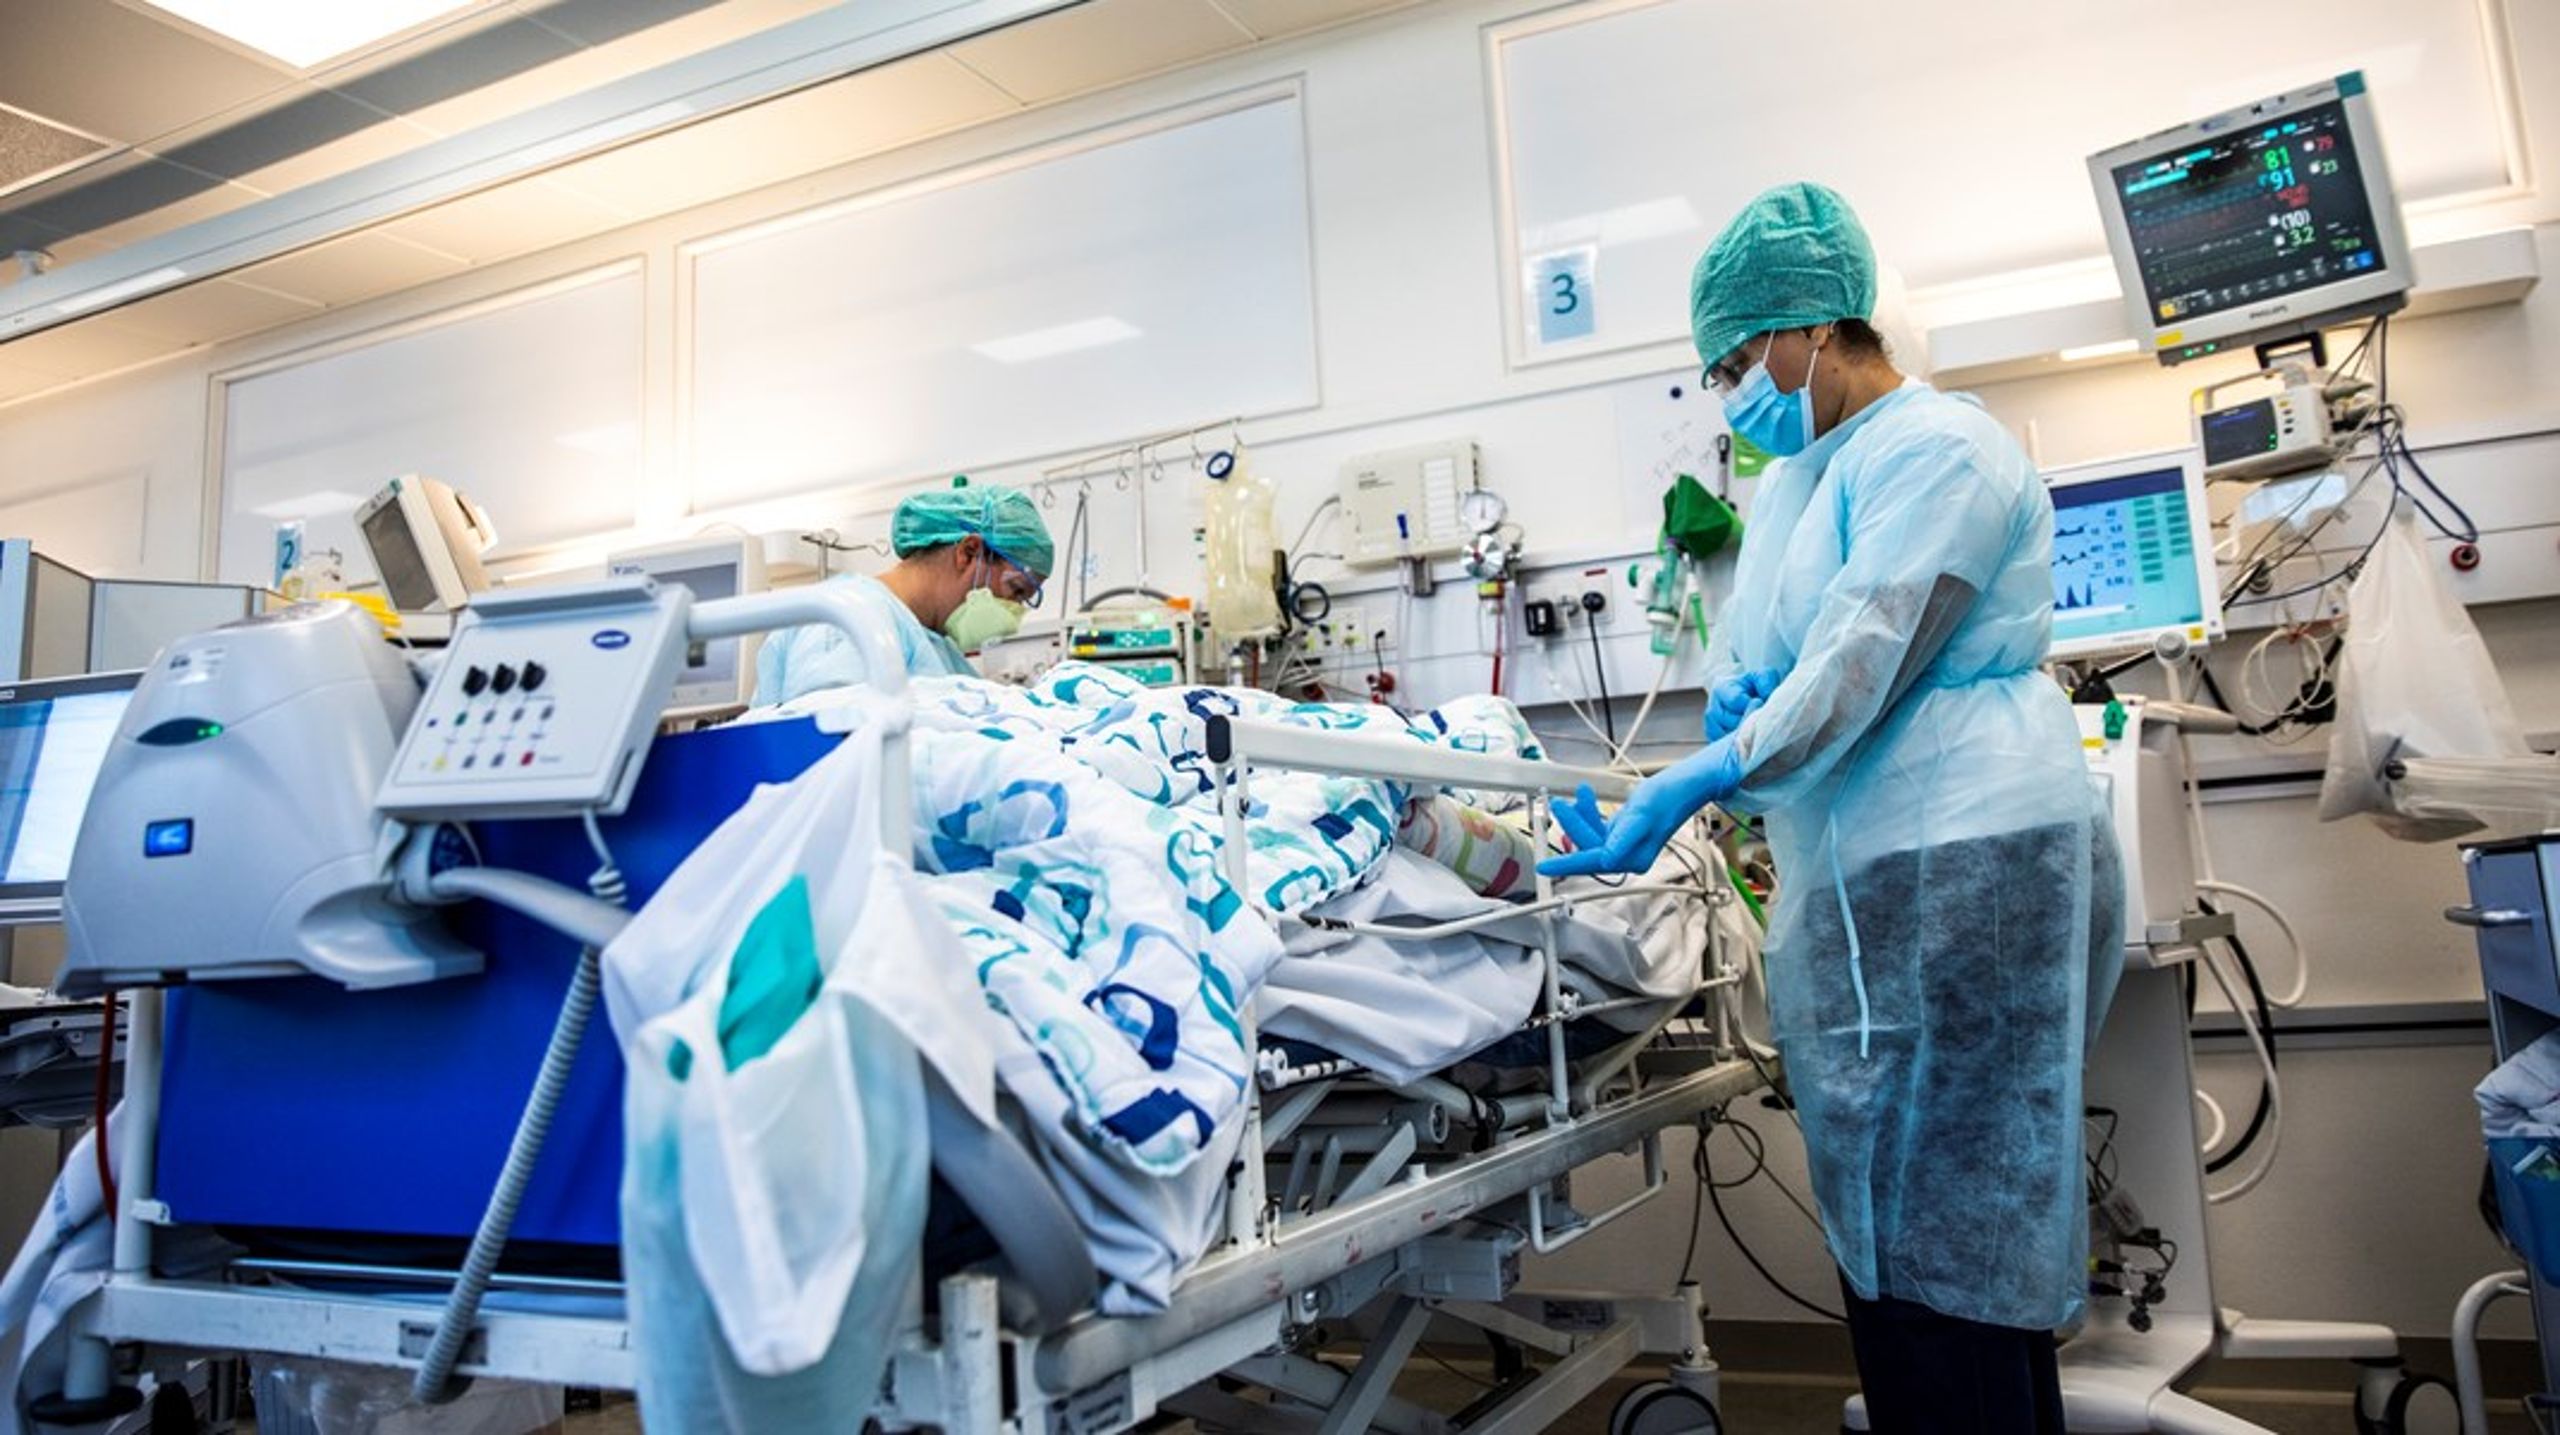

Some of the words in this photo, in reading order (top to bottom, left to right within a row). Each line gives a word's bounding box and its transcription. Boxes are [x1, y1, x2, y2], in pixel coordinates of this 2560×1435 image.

[2264, 146, 2290, 170] 81
[2269, 167, 2295, 191] 91
[1552, 273, 1577, 314] 3
[282, 540, 294, 569] 2
